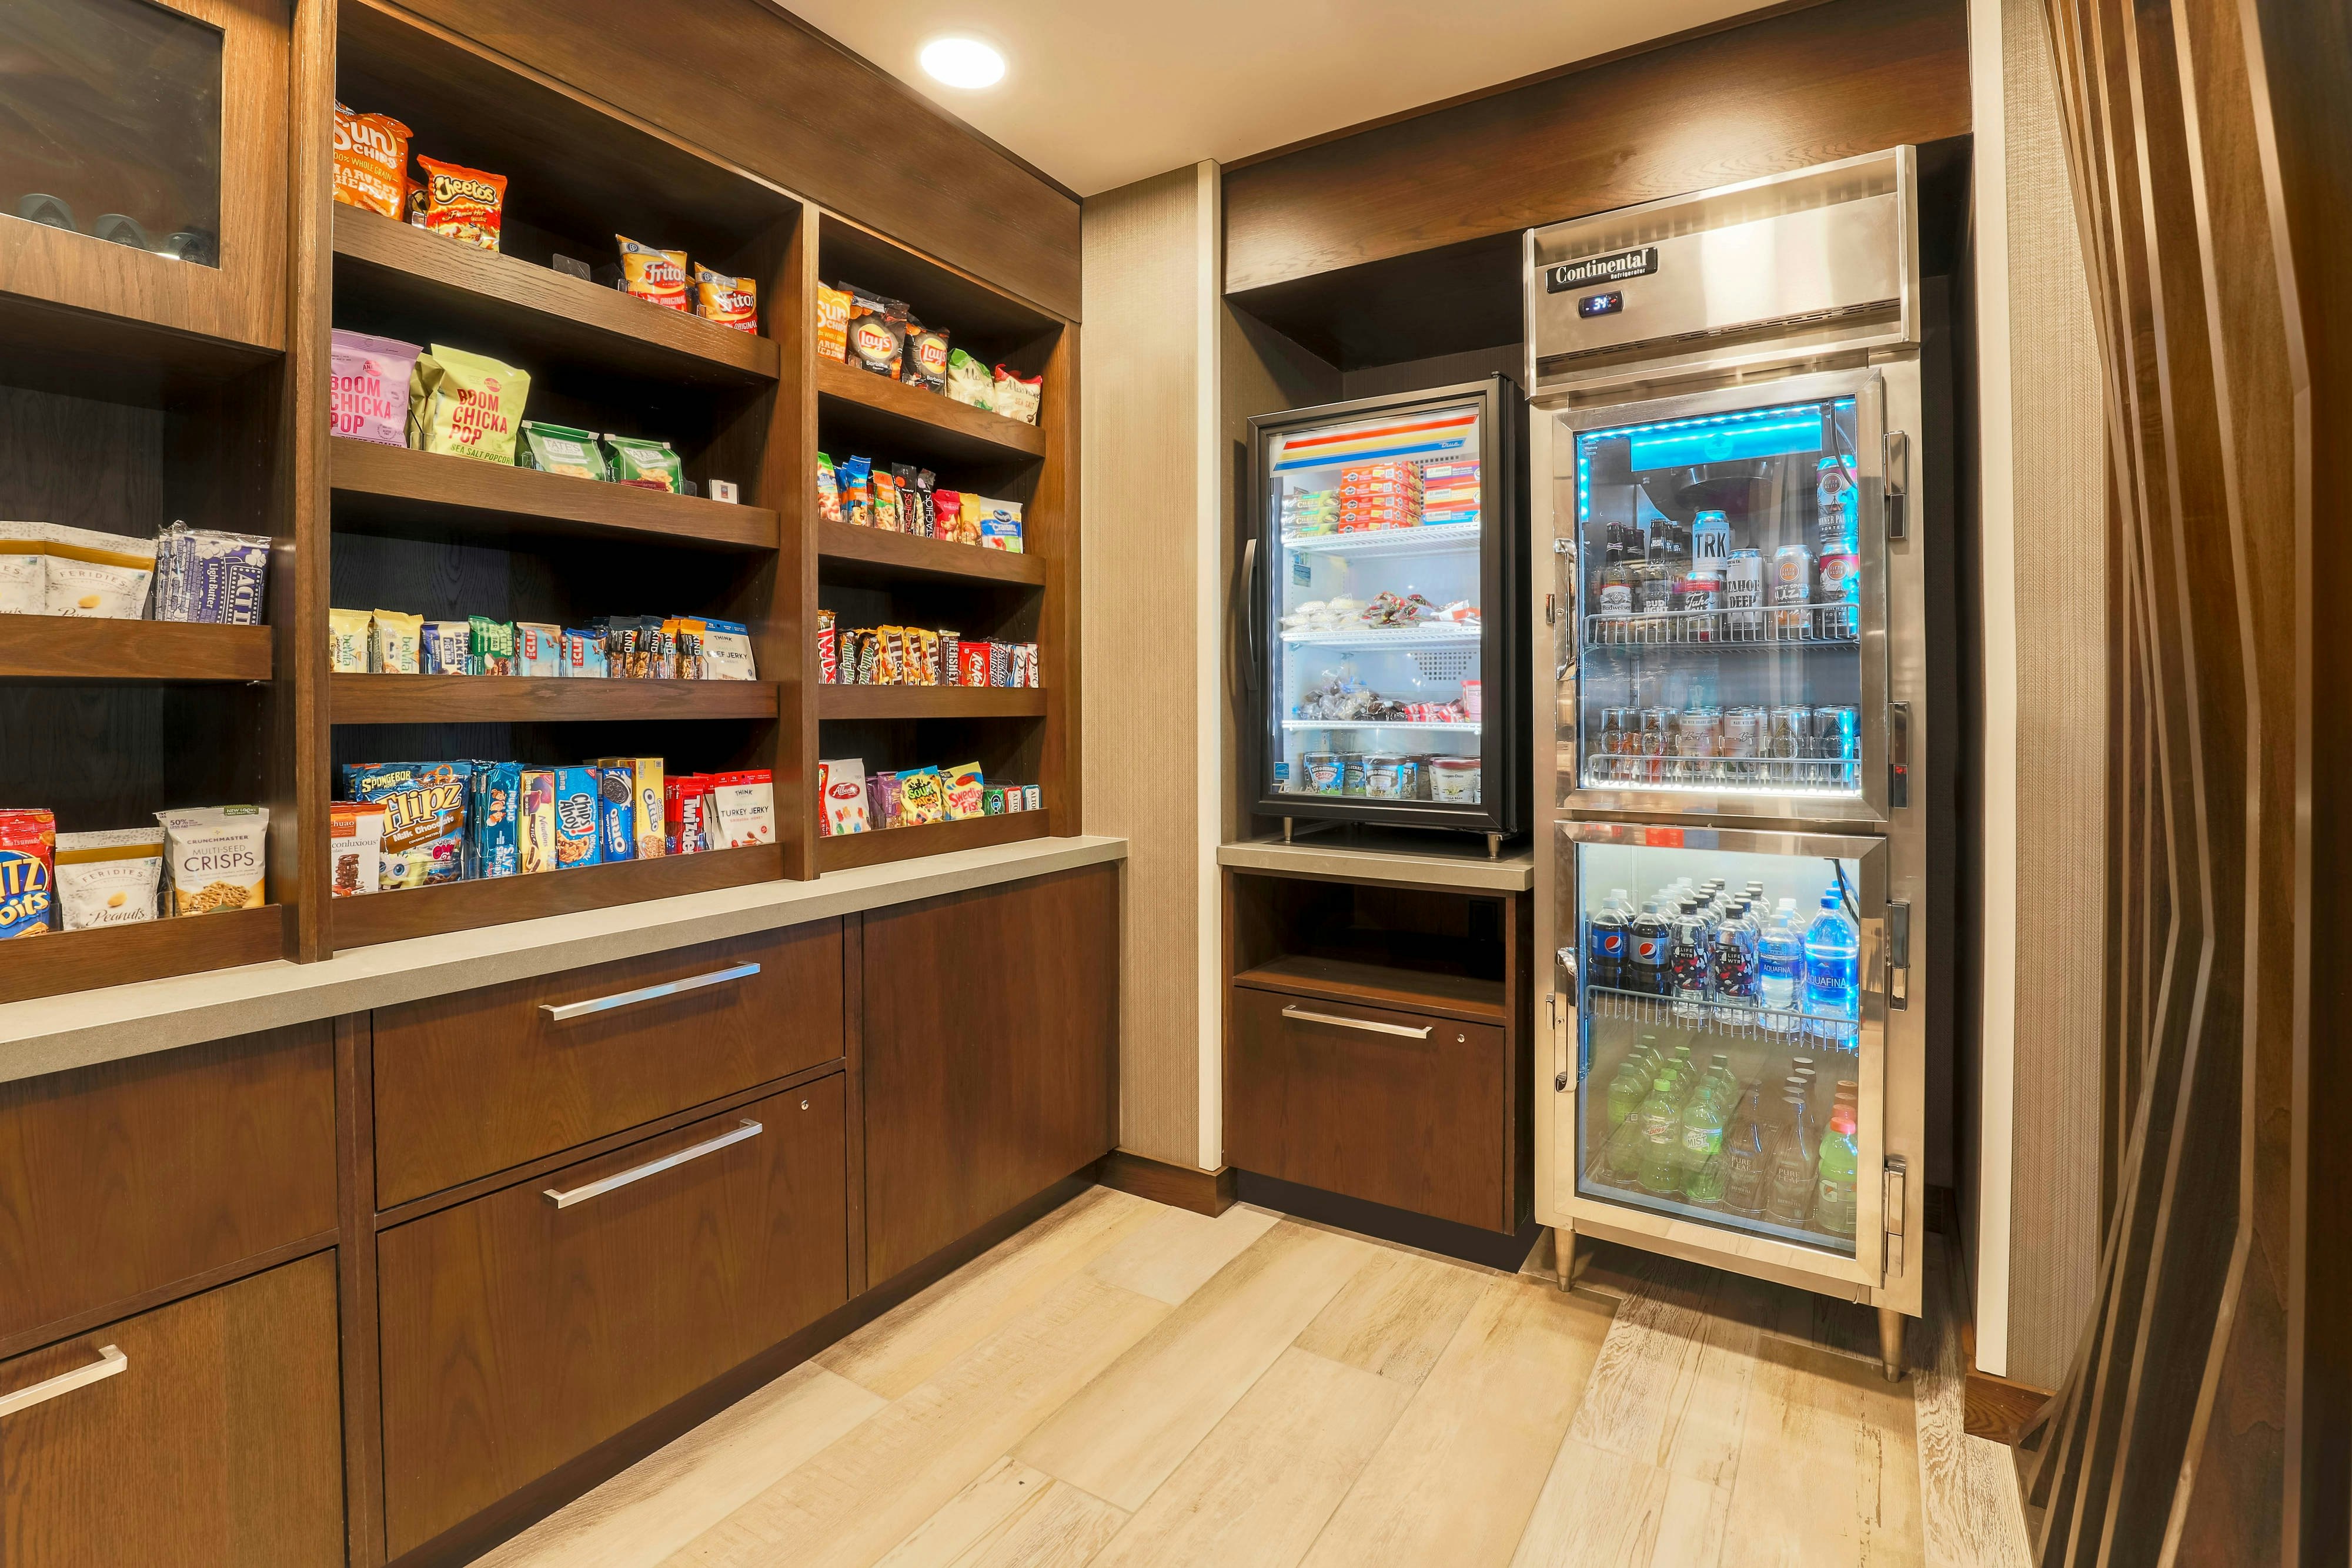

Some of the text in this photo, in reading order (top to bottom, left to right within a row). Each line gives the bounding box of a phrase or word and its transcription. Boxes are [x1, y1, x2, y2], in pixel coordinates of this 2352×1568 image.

[335, 116, 397, 156] Sun
[334, 152, 392, 181] 00% WHOLE GRAIN
[353, 144, 398, 169] CHIPS
[333, 163, 397, 196] HARVEST
[434, 176, 496, 203] Cheetos
[644, 261, 685, 285] Fritos
[1555, 248, 1649, 284] Continental
[1610, 268, 1646, 280] Refrigerator
[660, 295, 686, 305] ORIGINAL
[721, 291, 754, 313] Fritos
[1593, 297, 1607, 310] 34
[734, 320, 757, 330] ORIGINAL
[860, 330, 890, 351] Lay's
[923, 345, 946, 365] Lay's
[331, 376, 380, 397] BOOM
[927, 375, 944, 384] Barbecue
[331, 392, 391, 420] CHICKA
[457, 389, 499, 413] BOOM
[1025, 401, 1035, 409] SALT
[331, 412, 365, 434] POP
[453, 406, 508, 434] CHICKA
[449, 424, 483, 446] POP
[544, 439, 580, 452] TATE'S
[451, 443, 514, 466] SEA SALT POPCORN
[626, 449, 659, 457] TATE'S
[926, 494, 934, 538] STACHIOS
[1695, 531, 1726, 559] TRK
[60, 571, 128, 587] FERIDIES
[206, 563, 219, 609] Light Butter
[1728, 580, 1760, 593] TAHOE
[235, 573, 255, 609] ACT
[1685, 591, 1716, 611] Tahoe
[1730, 595, 1756, 607] DEEP
[1775, 588, 1809, 601] HAZE
[343, 634, 356, 666] belVita
[454, 632, 464, 671] BAKERY
[527, 630, 536, 653] CLIF
[573, 636, 582, 659] CLIF
[624, 630, 633, 653] KIND
[651, 630, 659, 653] KIND
[818, 621, 836, 684] TWIX
[402, 637, 416, 671] belVita
[841, 643, 855, 671] Milky
[857, 647, 874, 672] Milky
[949, 640, 958, 682] HERSHEY
[971, 653, 983, 687] Kit Kat
[1016, 653, 1025, 687] Dove
[1028, 650, 1038, 684] Dove
[362, 770, 412, 793] SPONGEBOB
[907, 784, 934, 799] SOUR
[376, 784, 462, 835] Flipz
[572, 794, 592, 826] Chips
[643, 789, 658, 831] OREO
[721, 806, 769, 817] TURKEY JERKY
[912, 793, 938, 808] PATCH
[393, 815, 454, 842] Milk Chocoate
[538, 815, 549, 847] Newtons
[610, 808, 626, 854] OREO
[682, 795, 700, 854] Twizzler
[187, 835, 249, 844] CRUNCHMASTER
[192, 845, 246, 857] MULTI-SEED
[332, 839, 377, 848] conluxious
[409, 836, 425, 844] COVERED
[583, 834, 596, 861] ORIGINAL
[184, 852, 254, 872] CRISPS
[494, 846, 504, 875] KRISPIES
[503, 845, 514, 874] EATS
[0, 857, 43, 897] ITZ
[82, 869, 143, 883] FERIDIES
[86, 907, 145, 926] Peanuts
[1763, 964, 1791, 973] AQUAFINA
[1808, 972, 1846, 987] AQUAFINA
[1688, 1136, 1706, 1146] MIST
[1732, 1156, 1750, 1165] PURE
[1732, 1162, 1750, 1171] LEAF
[1778, 1175, 1799, 1183] LEAF
[1779, 1168, 1800, 1178] PURE
[1819, 1179, 1838, 1202] G
